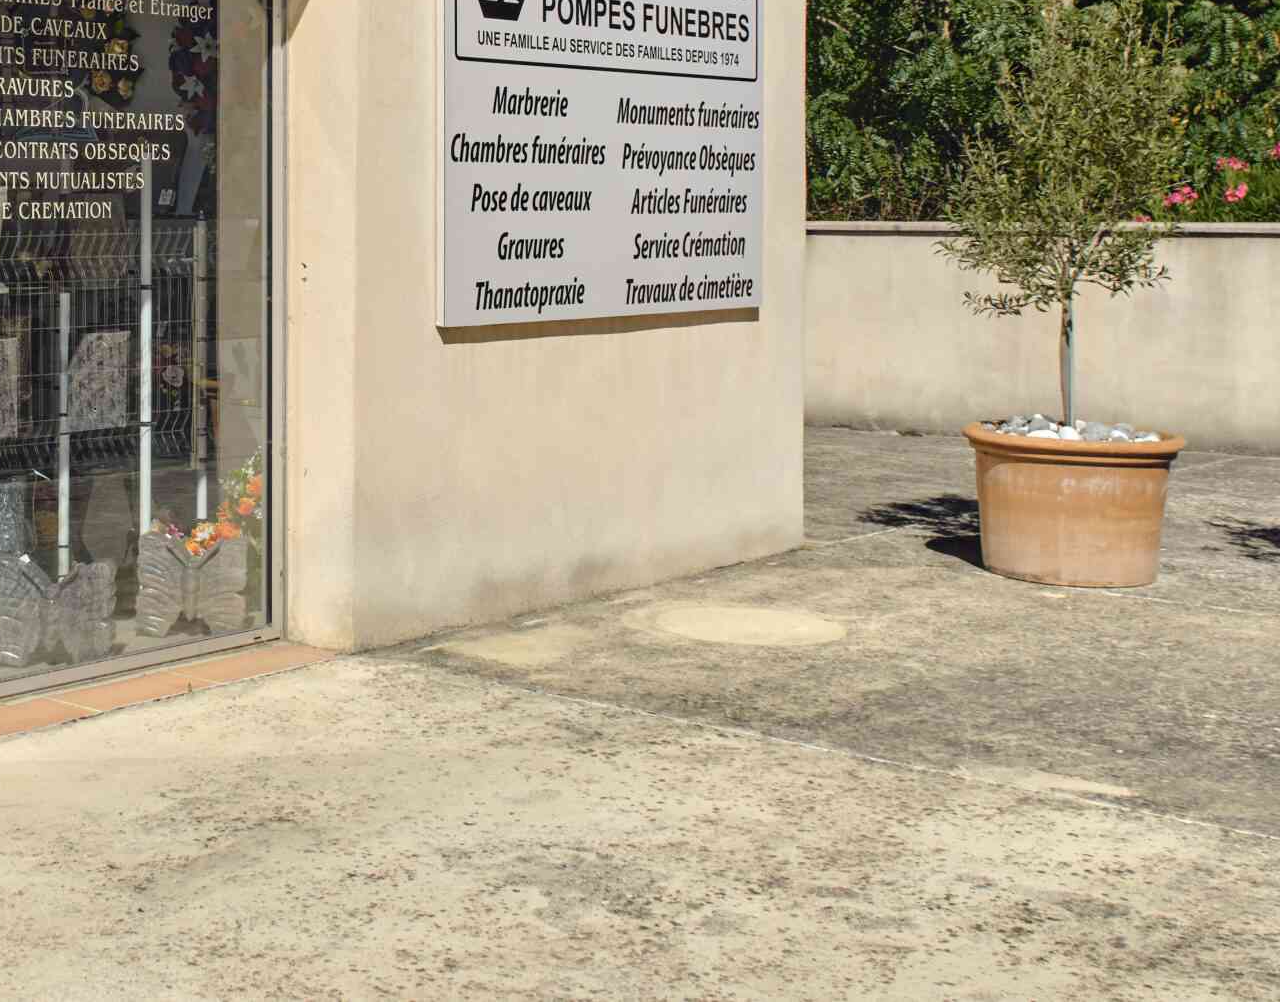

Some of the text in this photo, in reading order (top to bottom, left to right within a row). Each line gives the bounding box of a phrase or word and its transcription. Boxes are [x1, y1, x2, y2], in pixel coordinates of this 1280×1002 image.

[128, 0, 145, 14] et
[150, 0, 214, 23] Etranger
[642, 3, 750, 43] FUNEBRES
[0, 14, 24, 35] DE
[30, 17, 108, 41] CAVEAUX
[32, 48, 140, 72] FUNERAIRES
[477, 30, 740, 67] UNE FAMILLE AU SERVICE DES FAMILLES DEPUIS 1974
[493, 86, 569, 118] Marbrerie
[617, 97, 760, 131] Monuments funéraires
[82, 110, 185, 132] FUNERAIRES
[84, 142, 171, 163] OBSEQUES
[451, 133, 607, 167] Chambres funéraires
[622, 142, 756, 178] Prévoyance Obsèques
[35, 171, 145, 190] MUTUALISTES
[19, 201, 113, 220] CREMATION
[471, 183, 592, 213] Pose de caveaux
[631, 187, 748, 215] Articles Funéraires
[497, 231, 565, 261] Gravures
[633, 231, 746, 260] Service Crémation
[475, 279, 586, 315] Thanatopraxie
[625, 274, 754, 305] Travaux de cimetière
